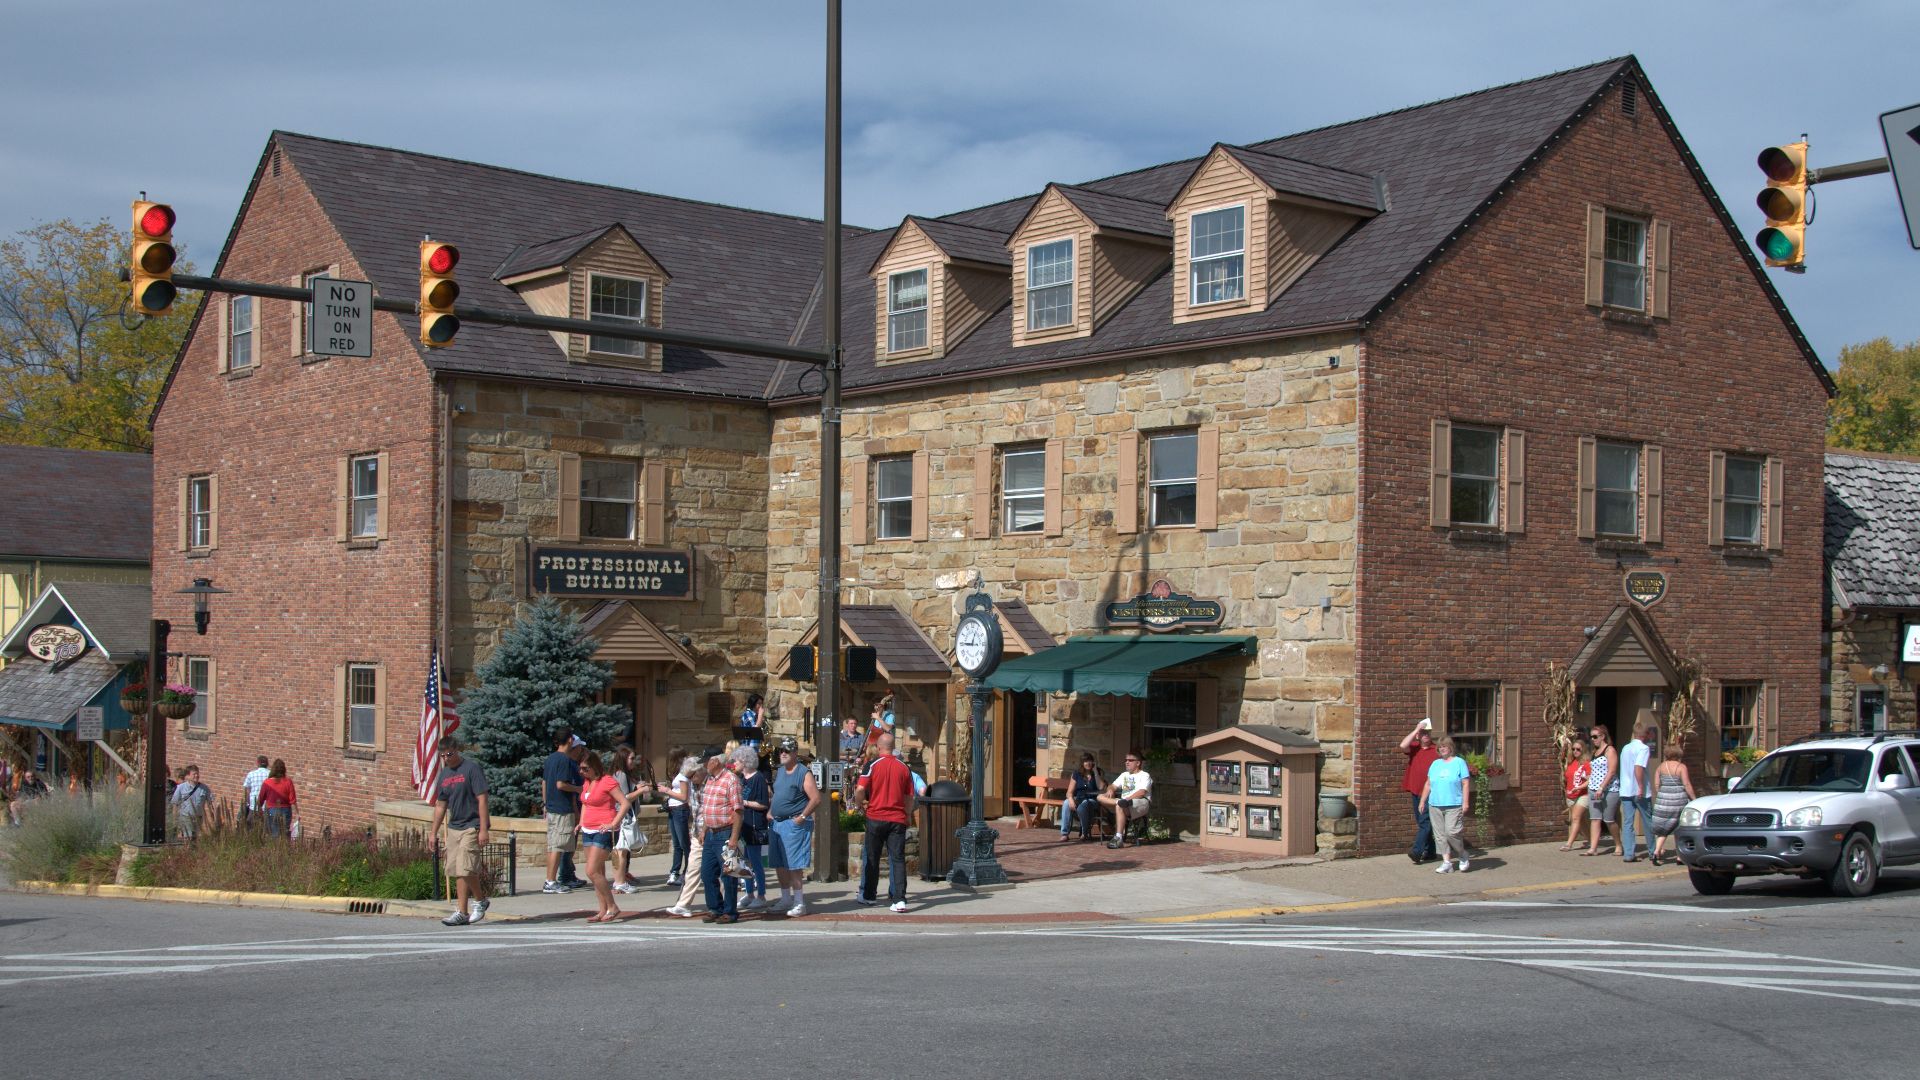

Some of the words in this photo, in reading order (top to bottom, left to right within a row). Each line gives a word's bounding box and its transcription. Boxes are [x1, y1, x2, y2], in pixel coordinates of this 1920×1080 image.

[331, 286, 355, 302] NO
[325, 304, 360, 319] TURN
[334, 321, 351, 334] ON
[330, 337, 355, 350] RED
[539, 556, 685, 574] PROFESSIONAL
[566, 574, 663, 590] BUILDING
[1111, 608, 1165, 616] VISITORS
[1167, 608, 1215, 616] CENTER
